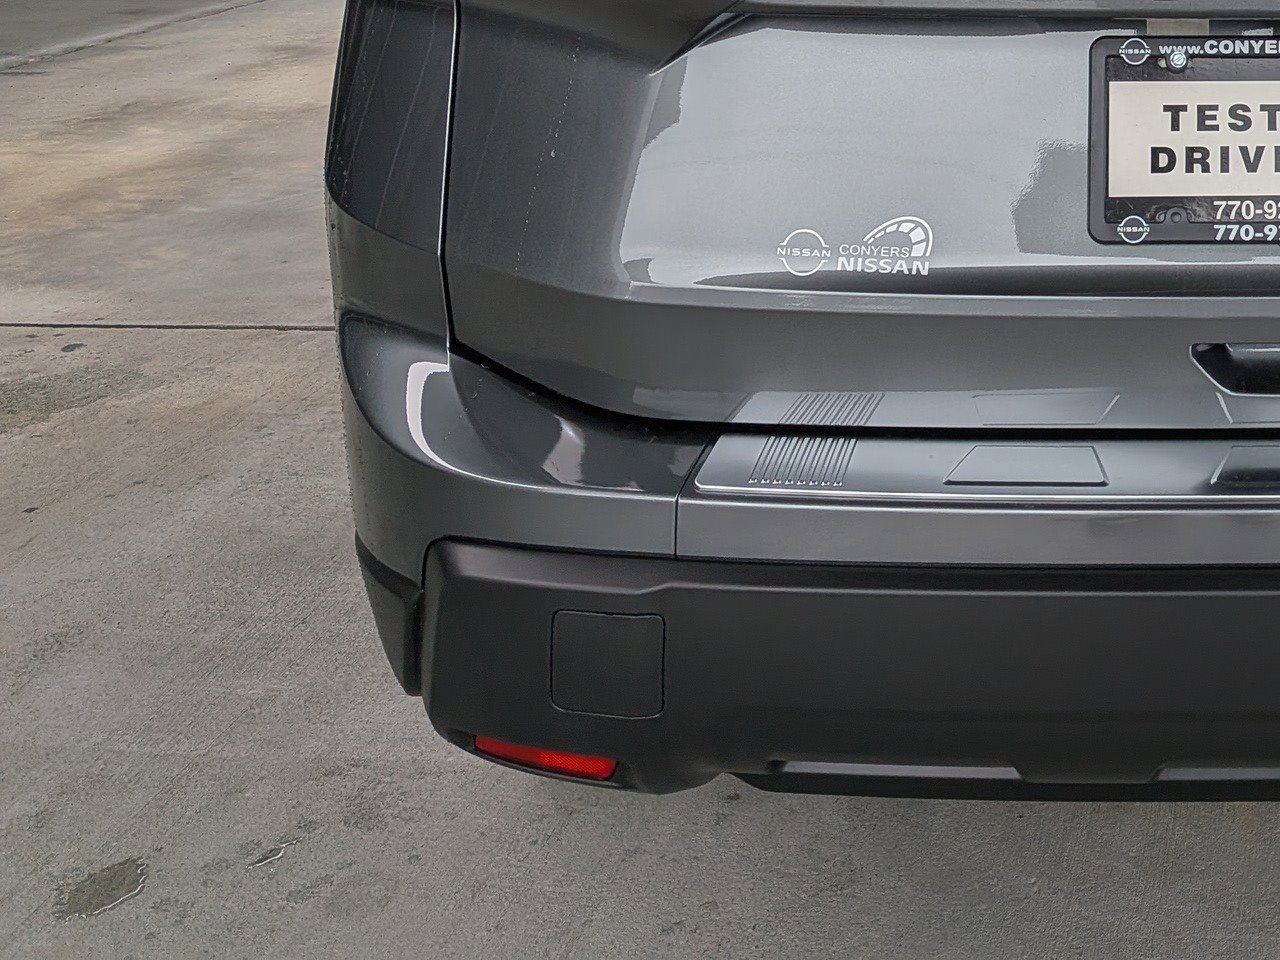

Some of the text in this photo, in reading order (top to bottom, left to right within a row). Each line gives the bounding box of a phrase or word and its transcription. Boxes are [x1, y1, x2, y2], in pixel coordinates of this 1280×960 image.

[776, 246, 831, 258] NISSAN
[839, 243, 911, 258] CONYERS
[836, 256, 930, 276] NISSAN
